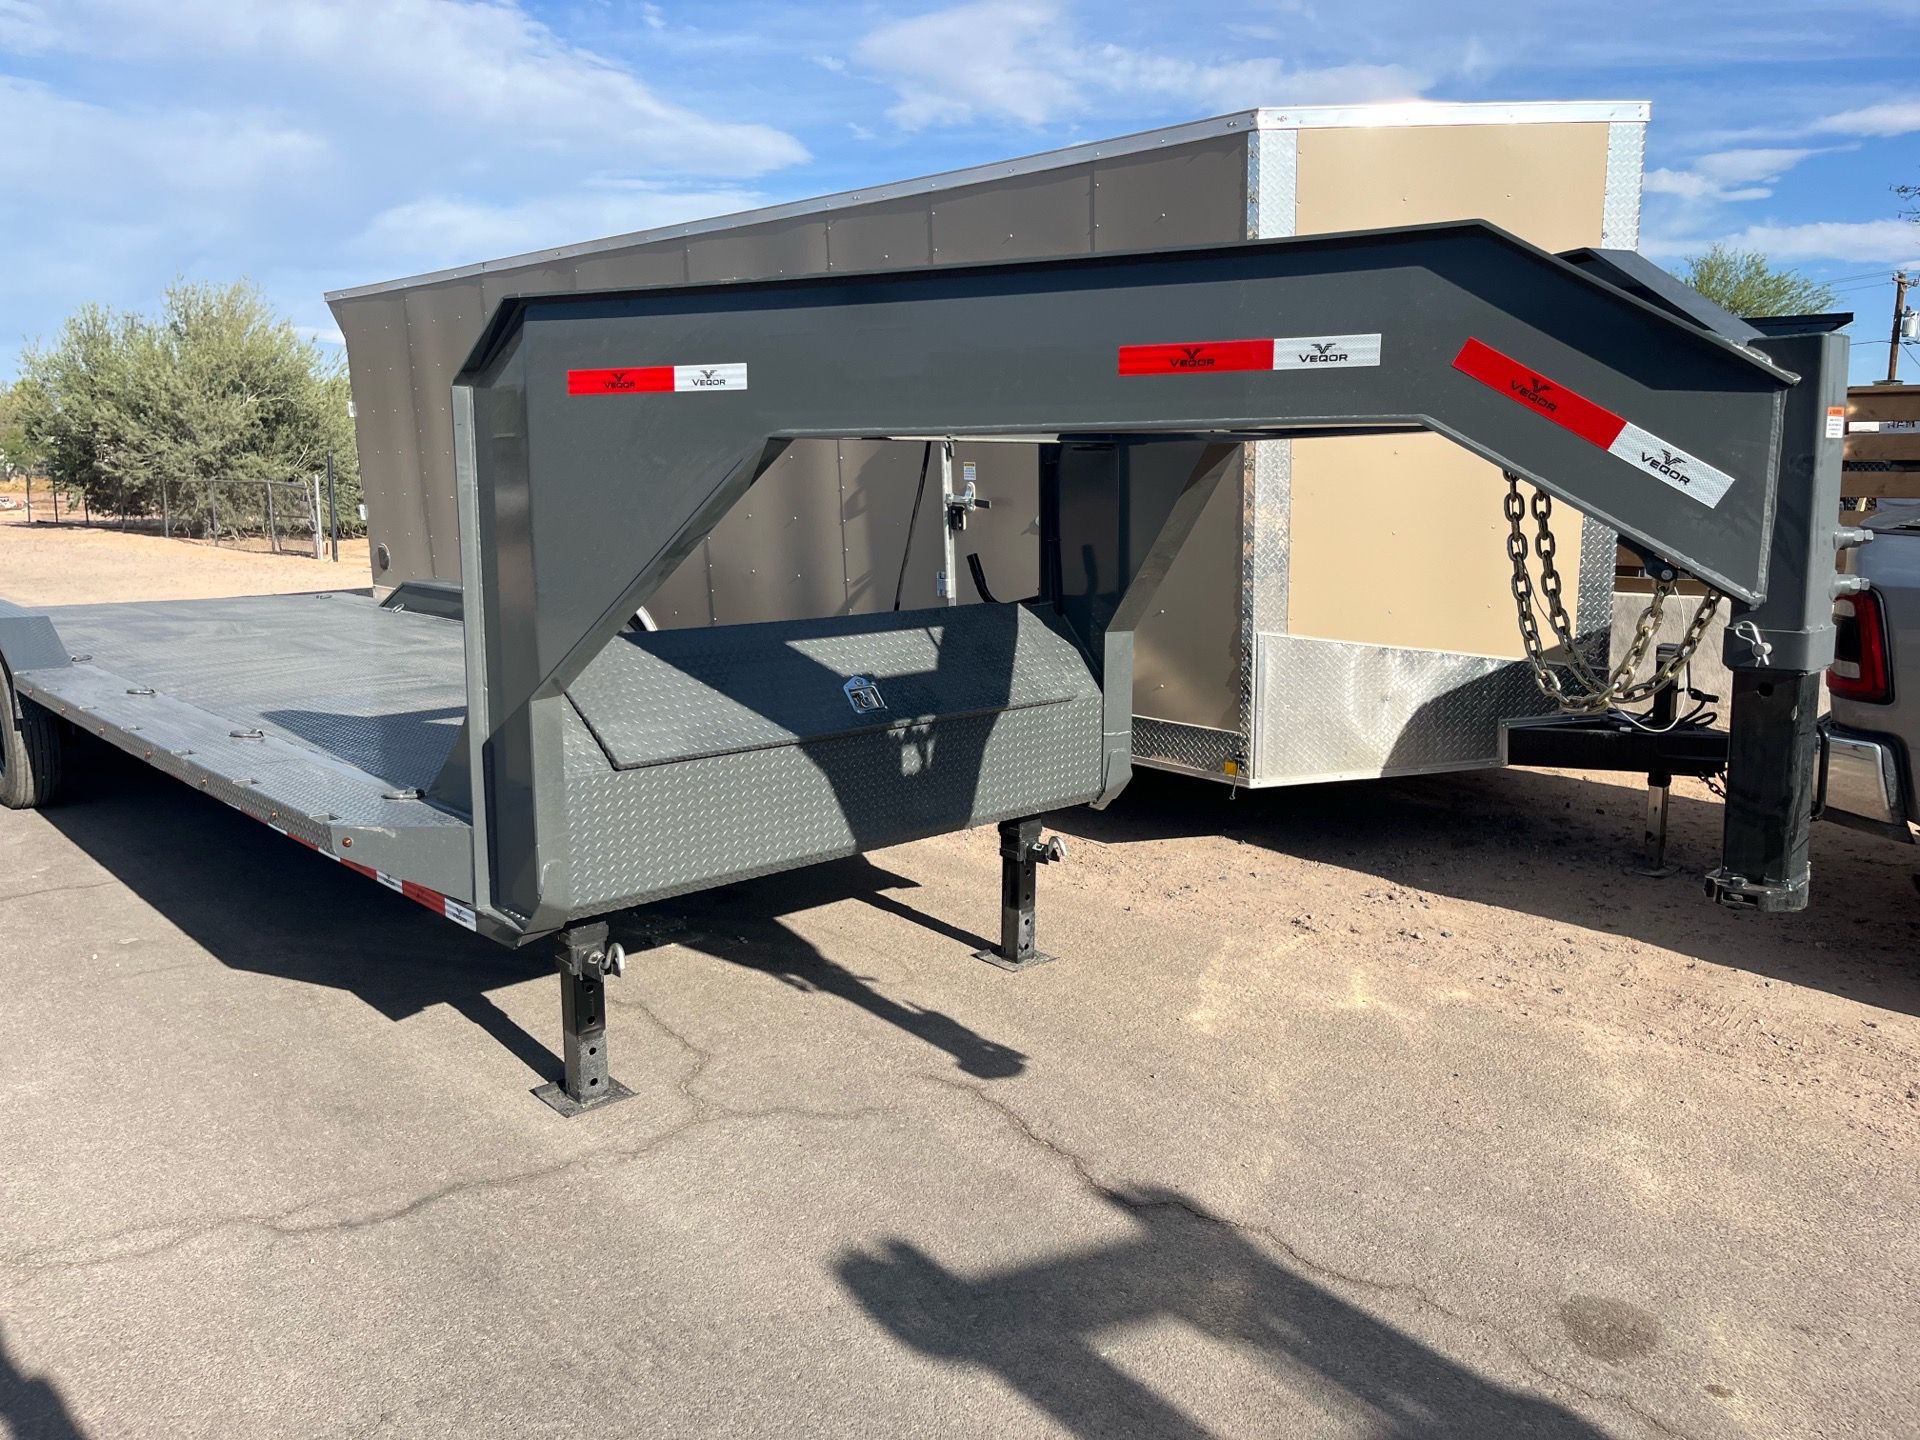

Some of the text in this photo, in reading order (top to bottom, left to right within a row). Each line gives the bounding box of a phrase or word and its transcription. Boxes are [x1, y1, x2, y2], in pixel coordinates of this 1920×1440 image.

[1169, 357, 1216, 368] VEQOR
[1298, 353, 1349, 363] VEQOR
[604, 381, 636, 389] VEQOR
[691, 378, 726, 387] VEQOR
[1510, 379, 1558, 413] VEQOR
[1640, 451, 1691, 487] VEQOR
